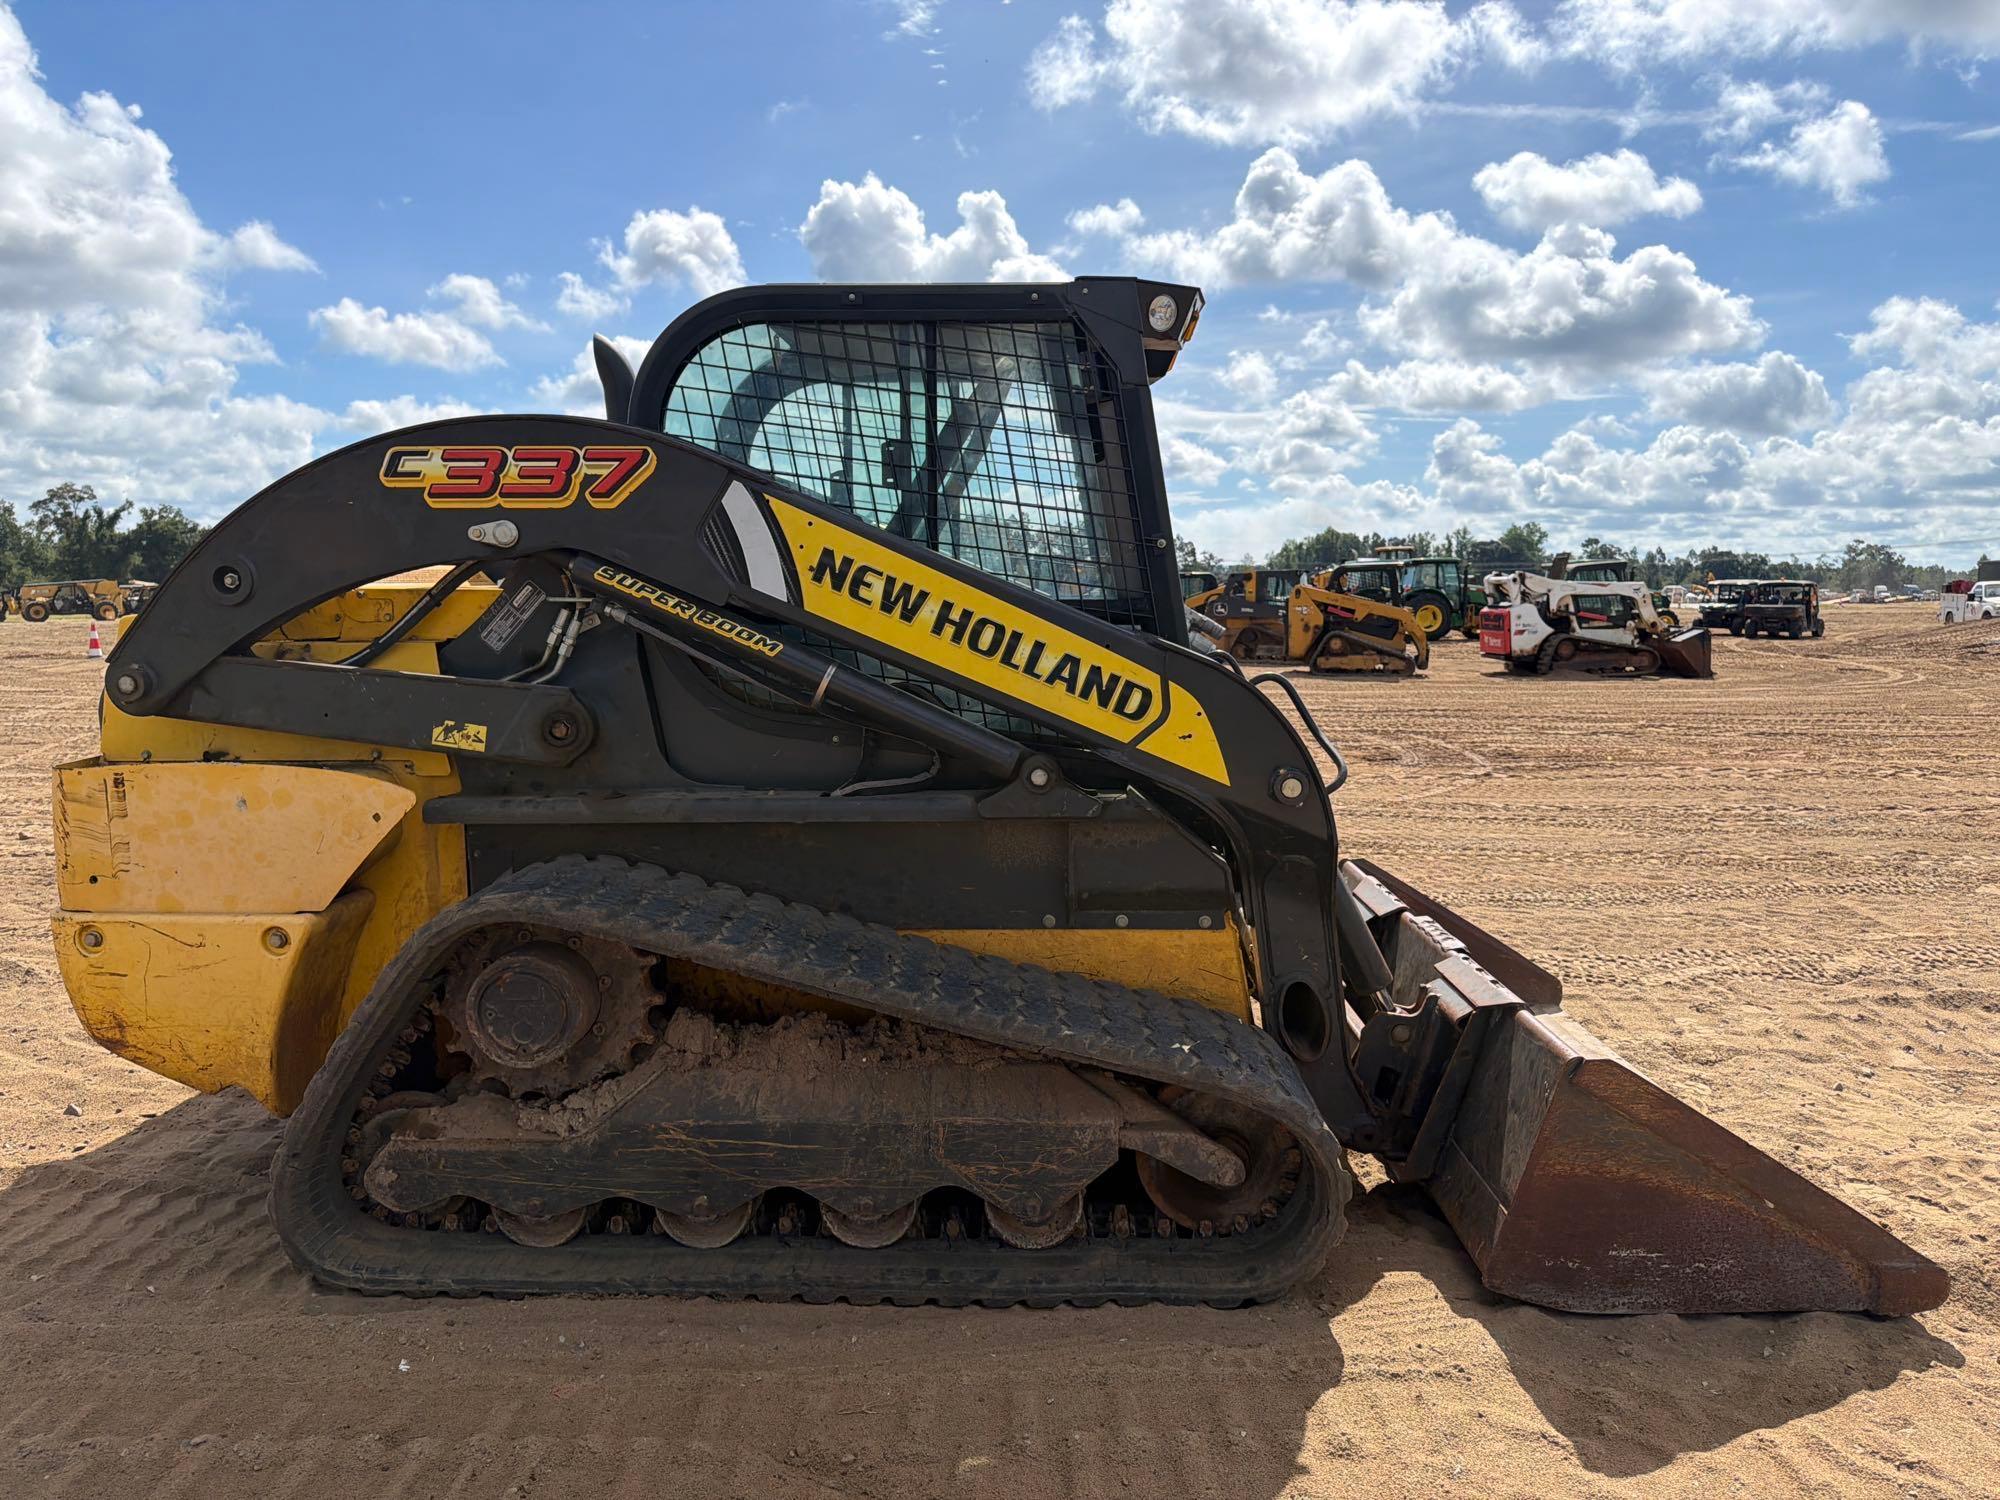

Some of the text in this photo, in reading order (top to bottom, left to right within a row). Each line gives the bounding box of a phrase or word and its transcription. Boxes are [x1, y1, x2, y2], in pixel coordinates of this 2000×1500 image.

[593, 566, 696, 618] SUPER
[693, 608, 783, 657] BOOM
[811, 547, 1153, 721] NEW HOLLAND
